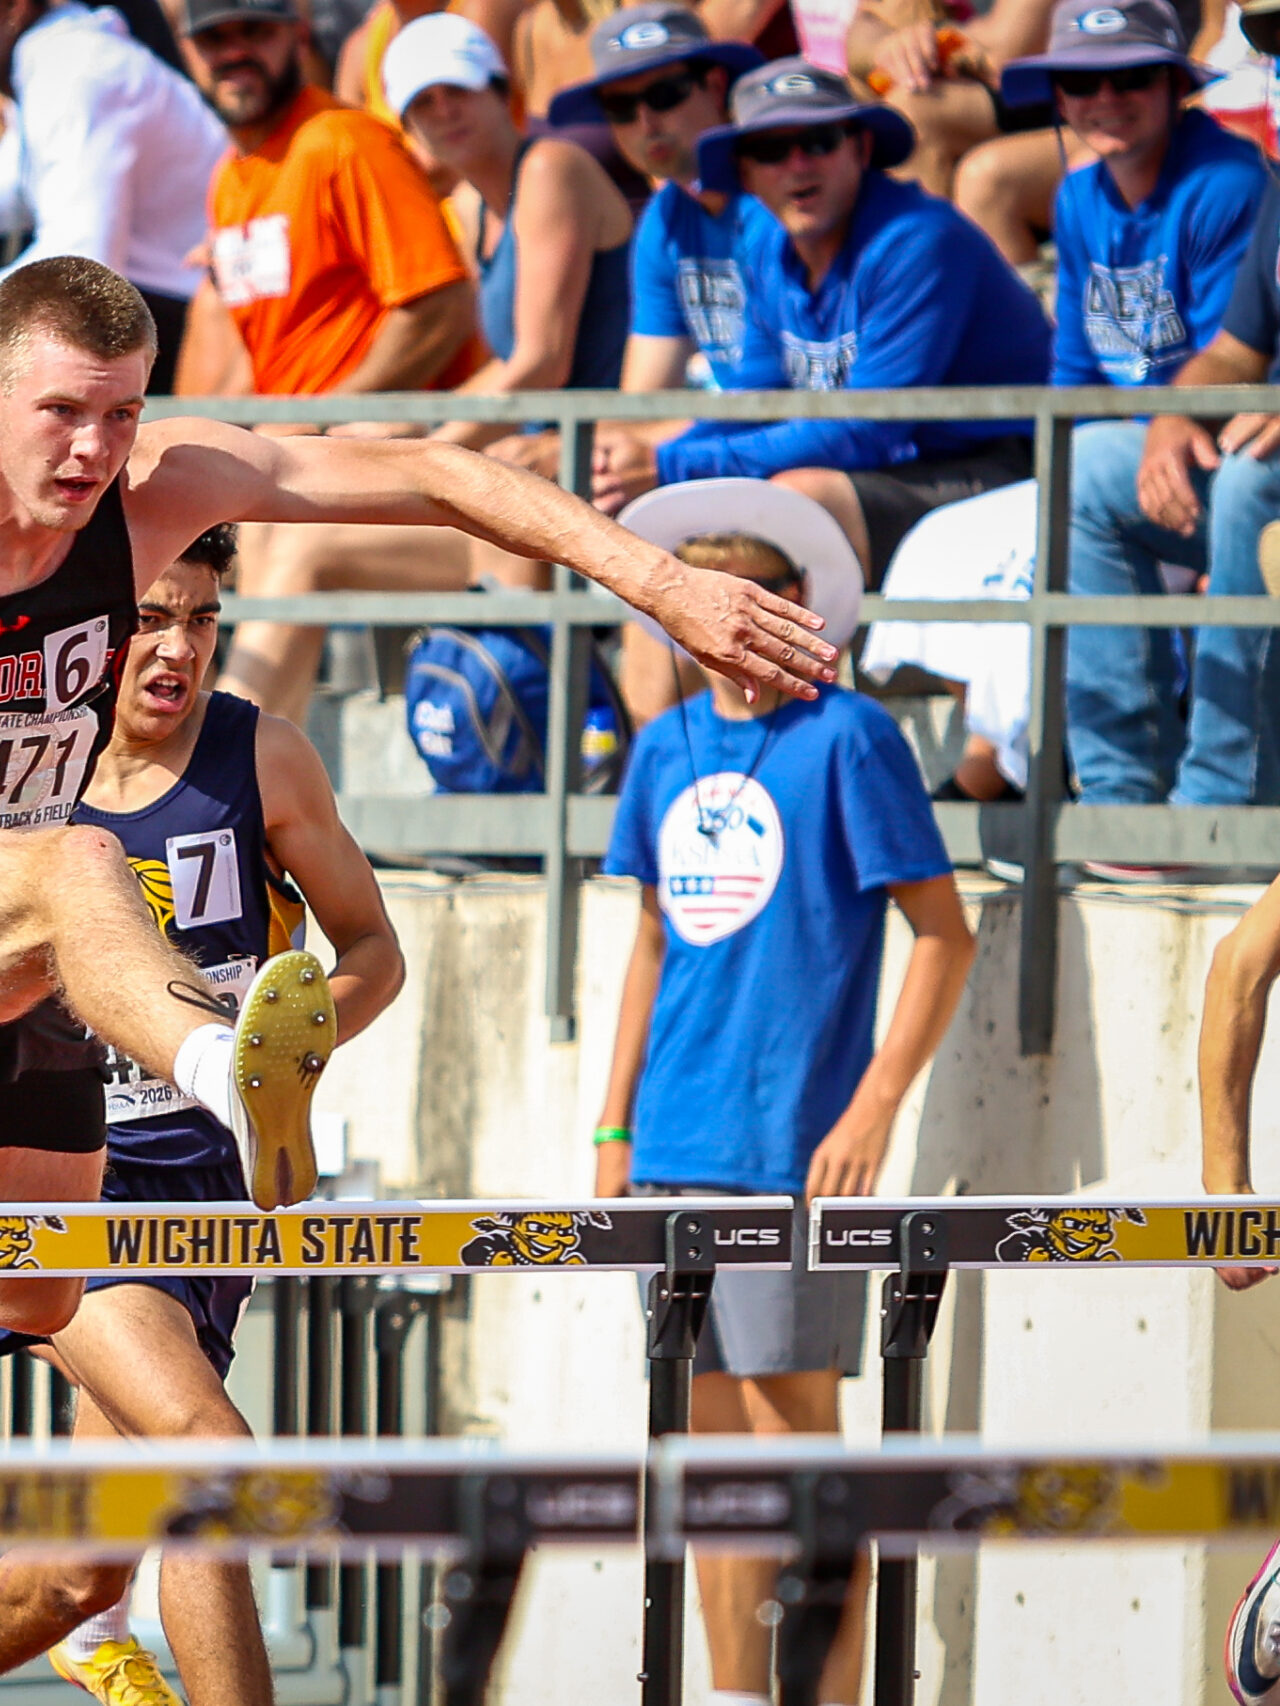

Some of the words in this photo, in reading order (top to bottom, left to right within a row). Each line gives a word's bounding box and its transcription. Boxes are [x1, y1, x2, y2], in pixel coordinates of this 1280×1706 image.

[55, 631, 90, 704] 6
[33, 809, 41, 824] &
[43, 802, 72, 821] FIELD
[177, 841, 215, 919] 7
[205, 964, 242, 985] ONSHIP
[140, 1085, 172, 1105] 2026
[106, 1217, 284, 1265] WICHITA
[301, 1216, 422, 1264] STATE
[713, 1229, 780, 1246] UCS
[826, 1229, 892, 1246] UCS
[1183, 1210, 1280, 1257] WICH
